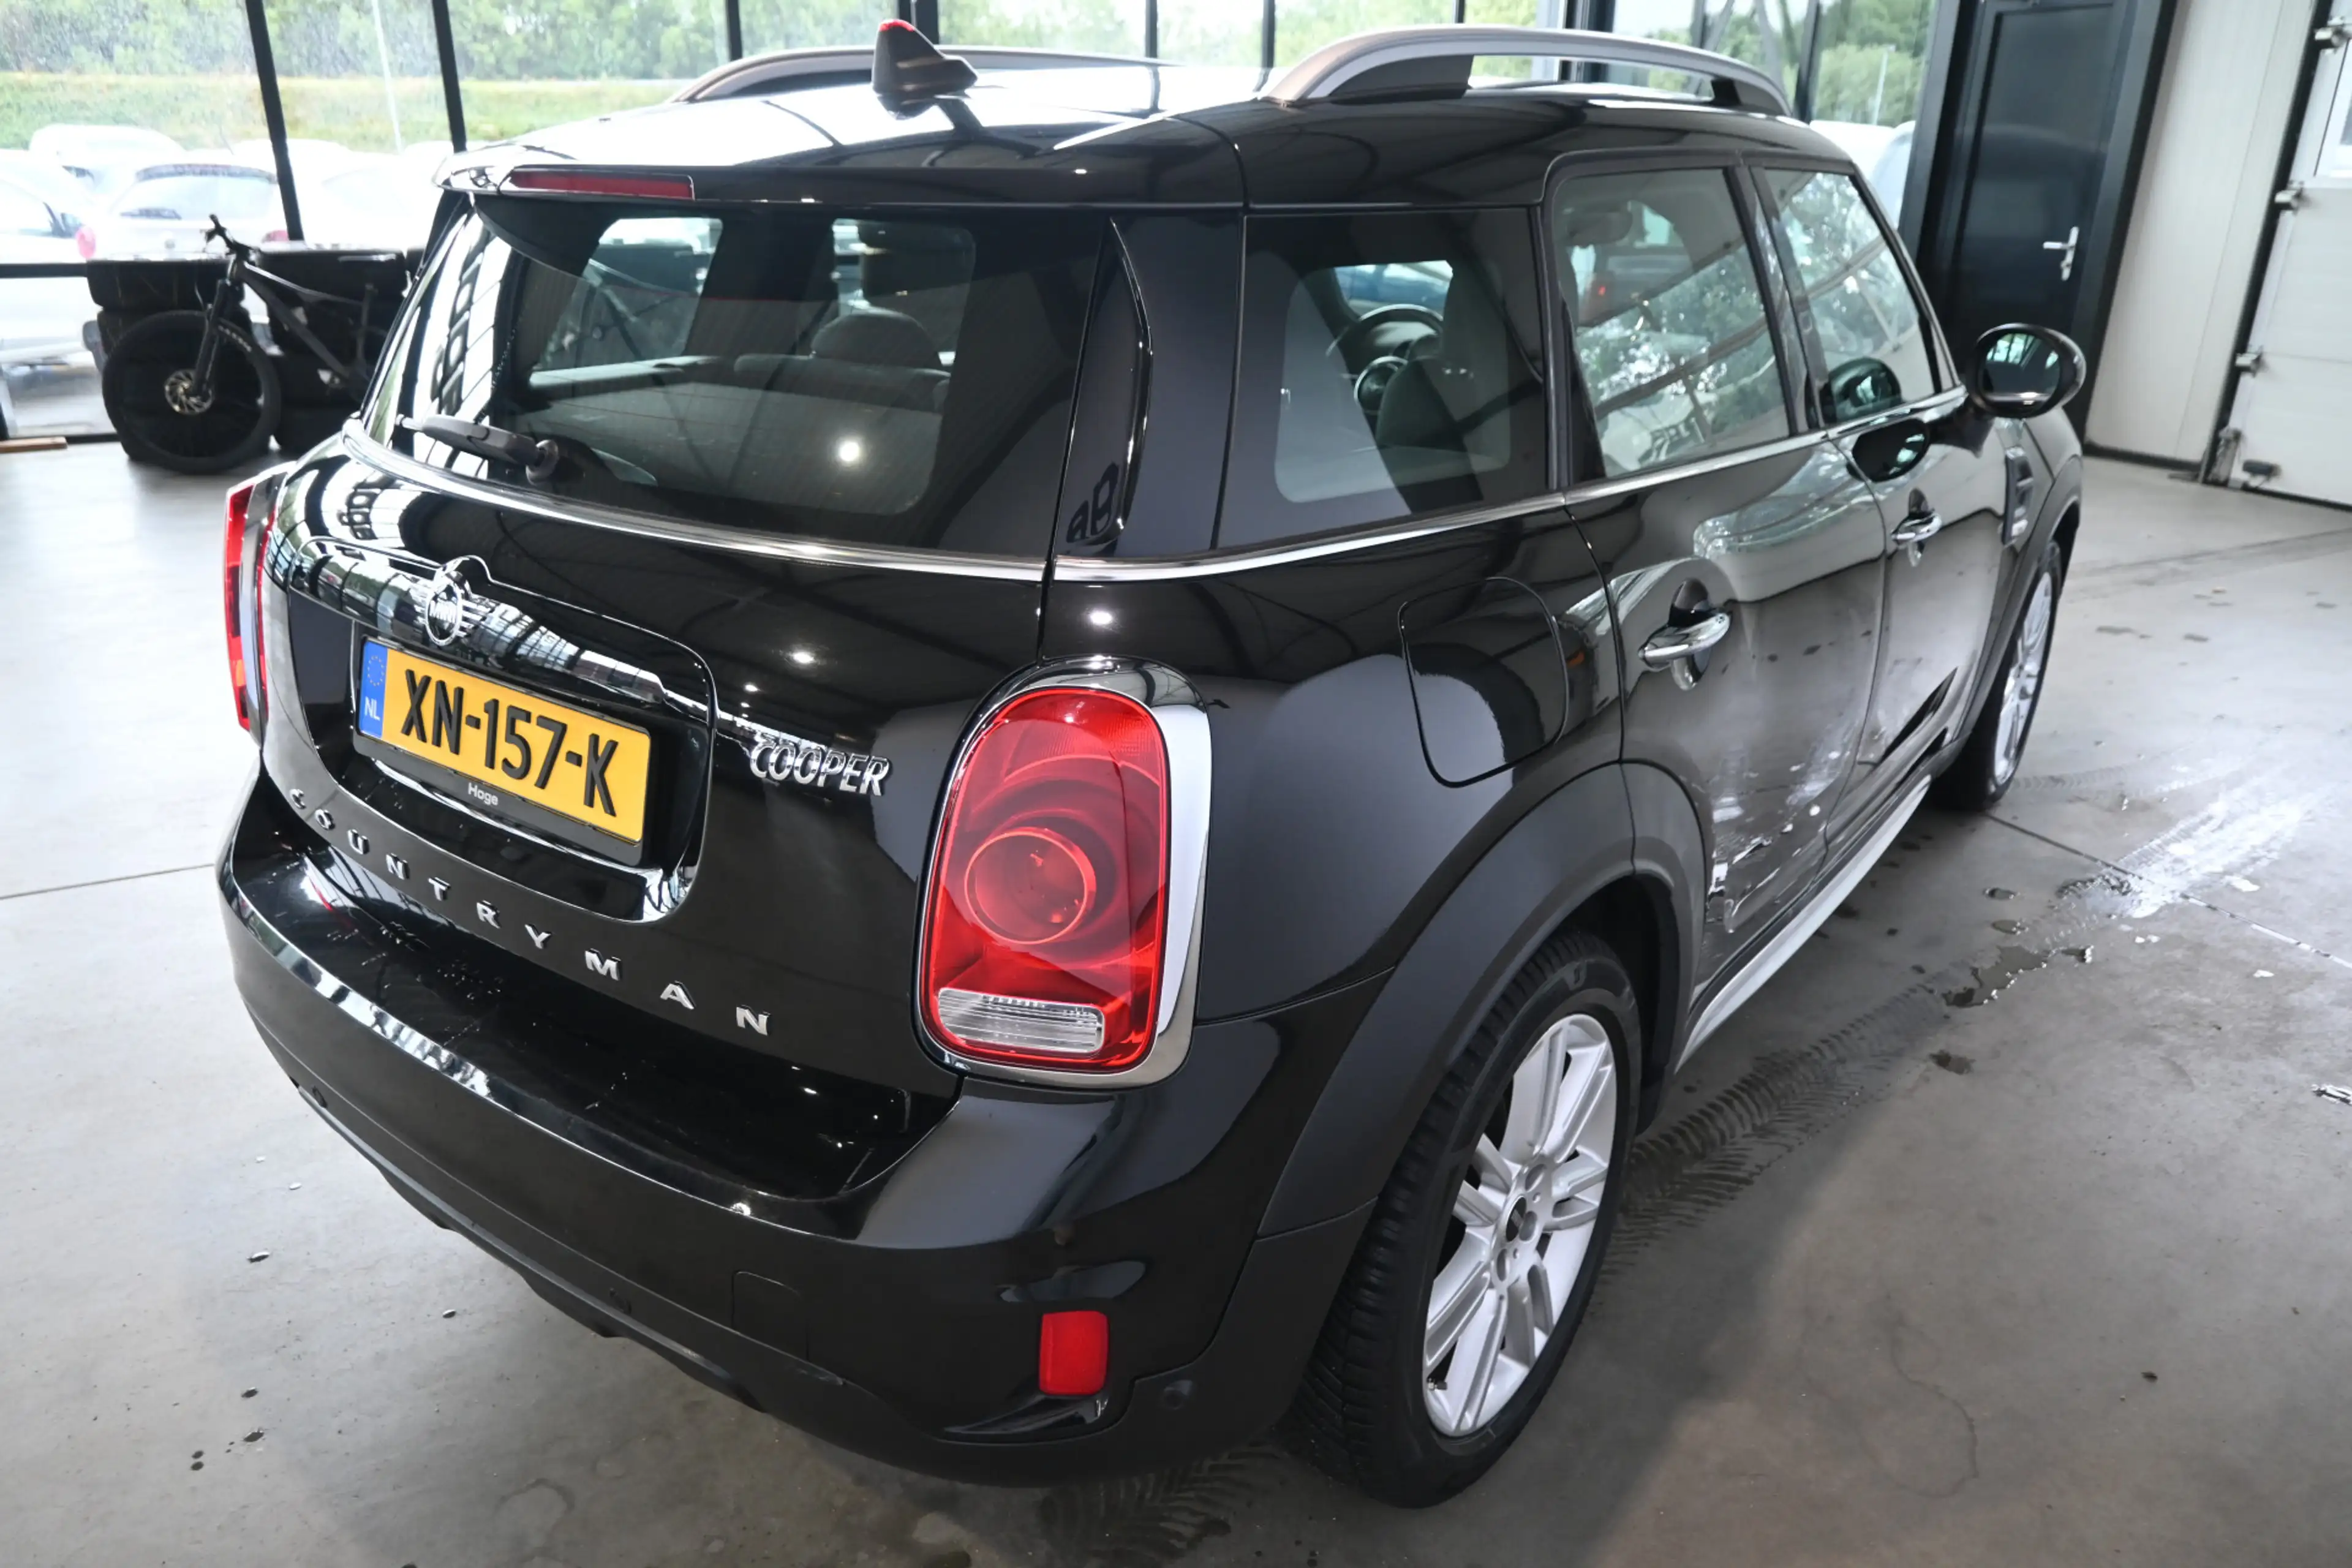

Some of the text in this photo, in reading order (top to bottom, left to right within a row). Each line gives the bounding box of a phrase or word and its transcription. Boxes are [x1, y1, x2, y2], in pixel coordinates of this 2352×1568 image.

[365, 696, 380, 721] NL
[401, 669, 619, 817] XN-157-K
[750, 741, 890, 796] COOPER
[290, 789, 771, 1036] COUNTRYMAN
